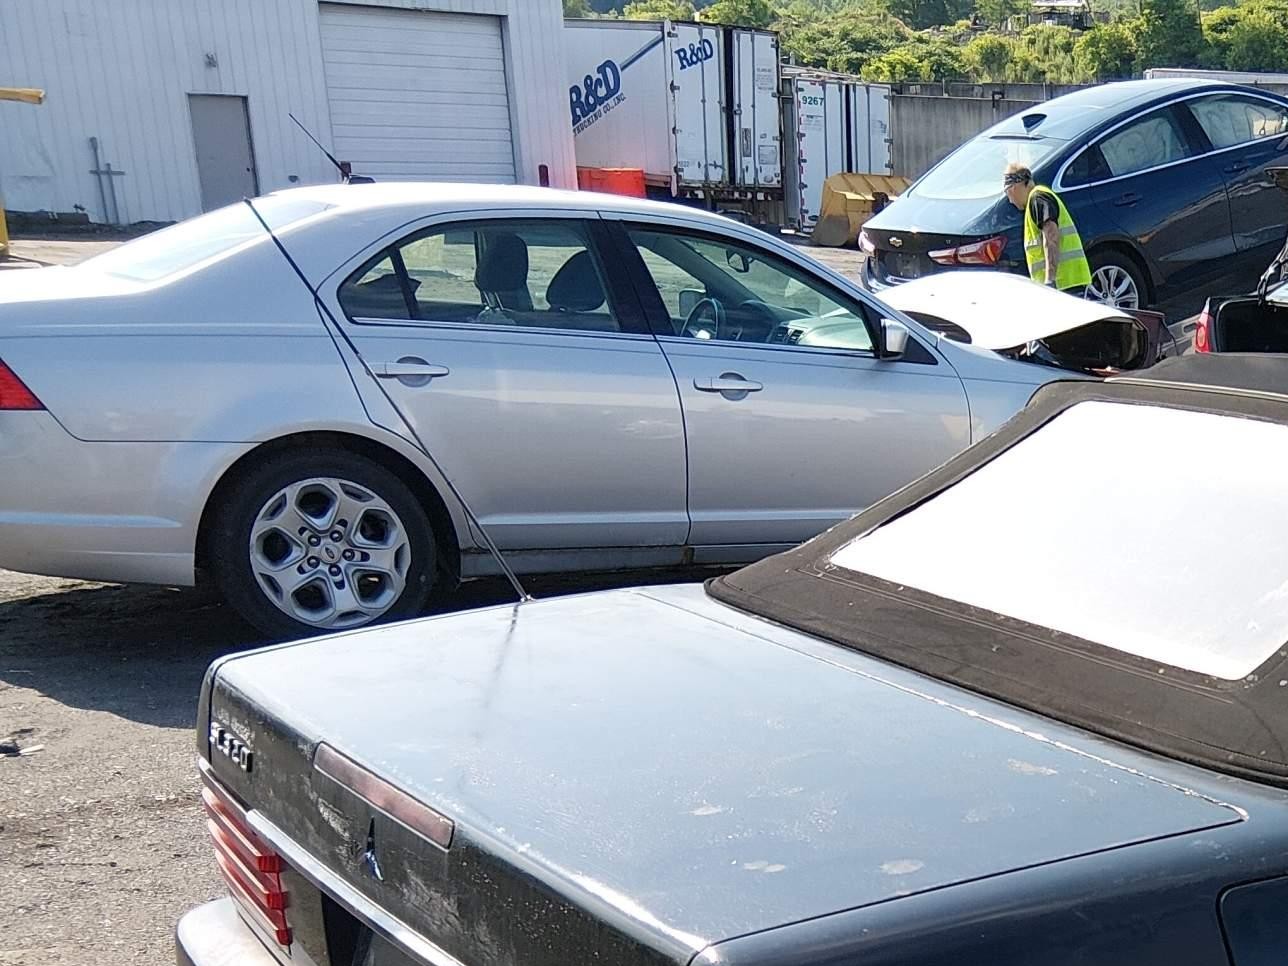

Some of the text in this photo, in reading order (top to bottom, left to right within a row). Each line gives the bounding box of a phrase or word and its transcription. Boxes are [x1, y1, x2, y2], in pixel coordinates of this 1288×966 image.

[674, 38, 714, 70] R&D
[569, 59, 621, 128] R&D
[802, 95, 825, 106] 9267
